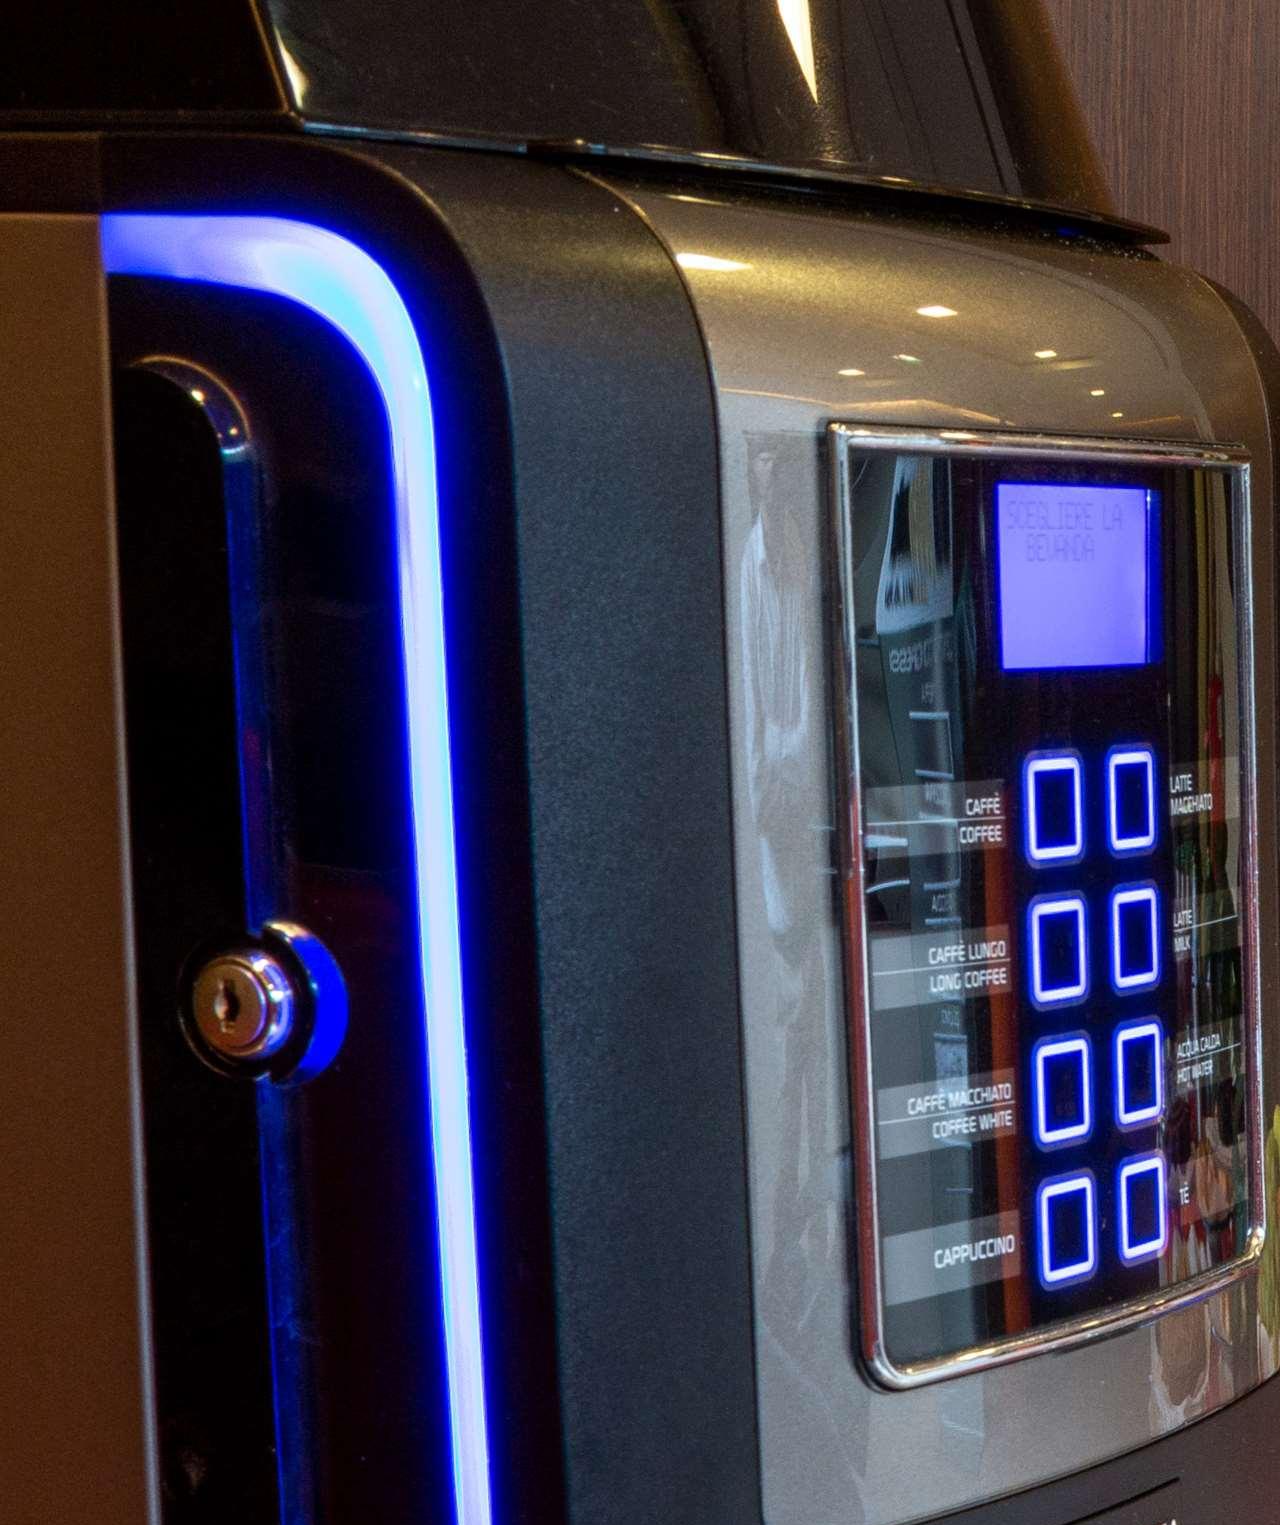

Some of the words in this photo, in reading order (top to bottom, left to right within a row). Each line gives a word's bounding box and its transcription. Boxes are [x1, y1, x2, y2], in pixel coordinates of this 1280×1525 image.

[1169, 774, 1193, 794] LATTE
[965, 791, 1001, 816] CAFFÈ
[959, 824, 1003, 844] COFFEE
[928, 939, 966, 965] CAFFÈ
[968, 940, 1006, 961] LUNGO
[930, 972, 961, 993] LONG
[964, 967, 1007, 988] COFFEE
[907, 1087, 945, 1116] CAFFÈ
[948, 1082, 1012, 1109] MACCHIATO
[932, 1115, 976, 1139] COFFEE
[978, 1109, 1013, 1132] WHITE
[934, 1234, 1015, 1269] CAPPUCCINO
